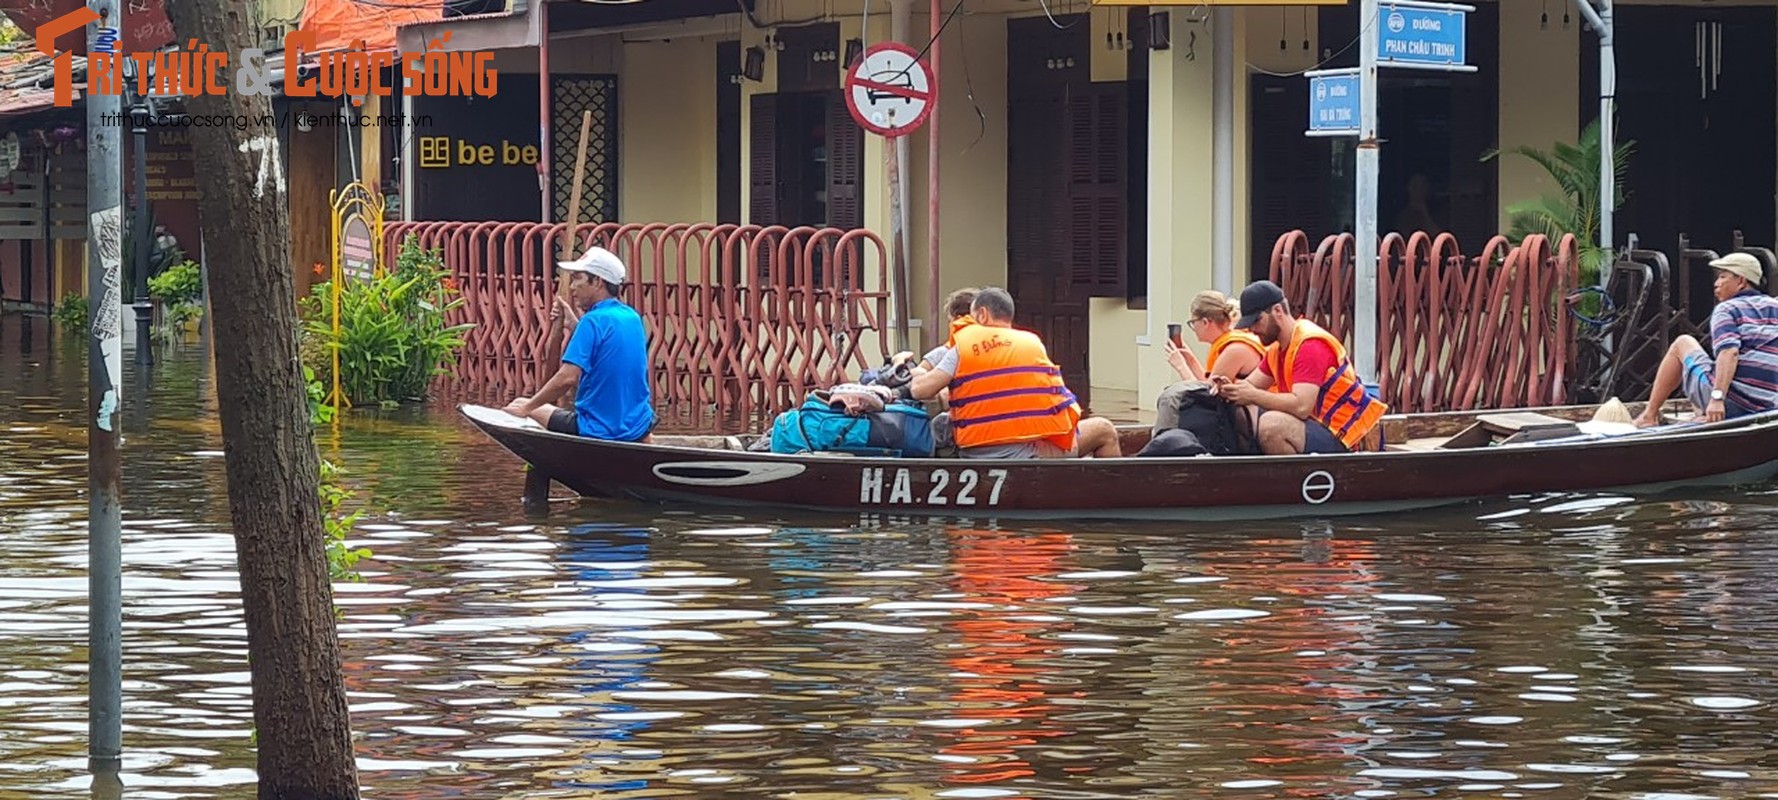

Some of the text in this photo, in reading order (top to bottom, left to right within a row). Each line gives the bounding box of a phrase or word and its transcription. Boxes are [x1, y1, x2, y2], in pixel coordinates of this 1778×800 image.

[1385, 39, 1456, 56] PHAN CHÂU TRINH
[458, 139, 539, 165] be be
